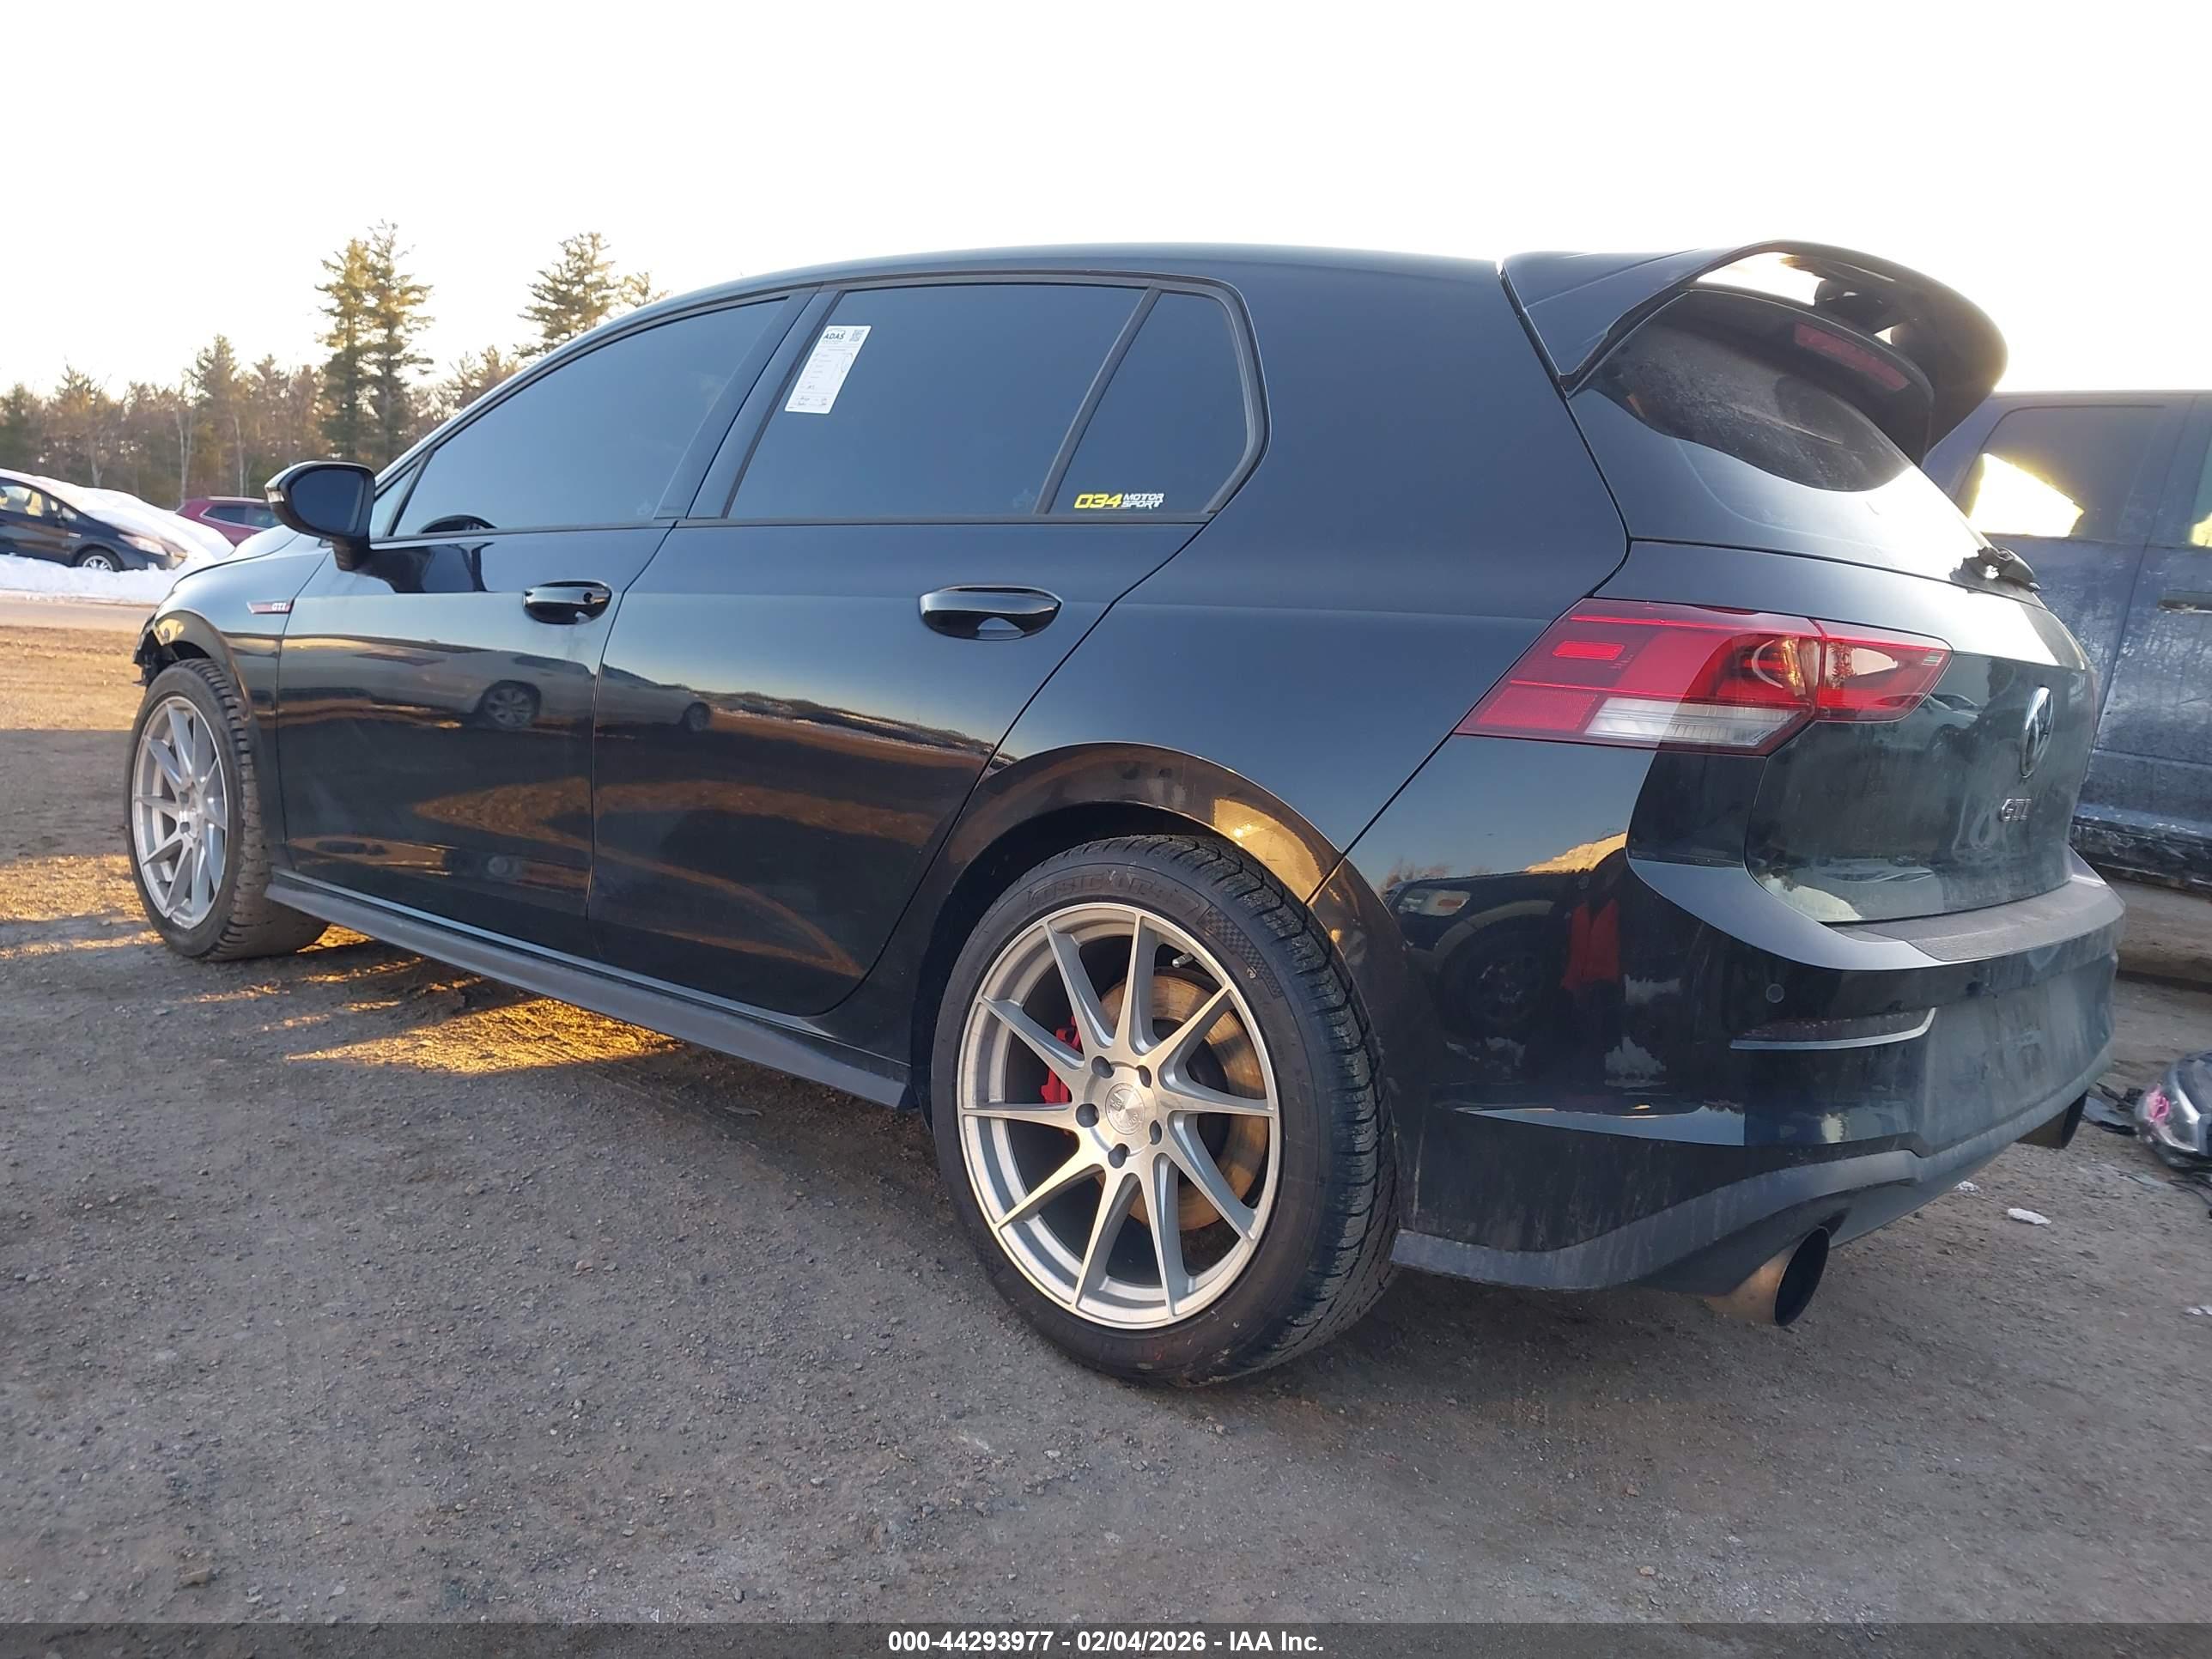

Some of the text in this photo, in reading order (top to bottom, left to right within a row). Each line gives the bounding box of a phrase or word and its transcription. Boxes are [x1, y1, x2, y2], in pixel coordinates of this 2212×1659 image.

[1073, 493, 1164, 509] 034 MOTOR
[1121, 501, 1161, 510] SPORT
[271, 602, 287, 611] GTI
